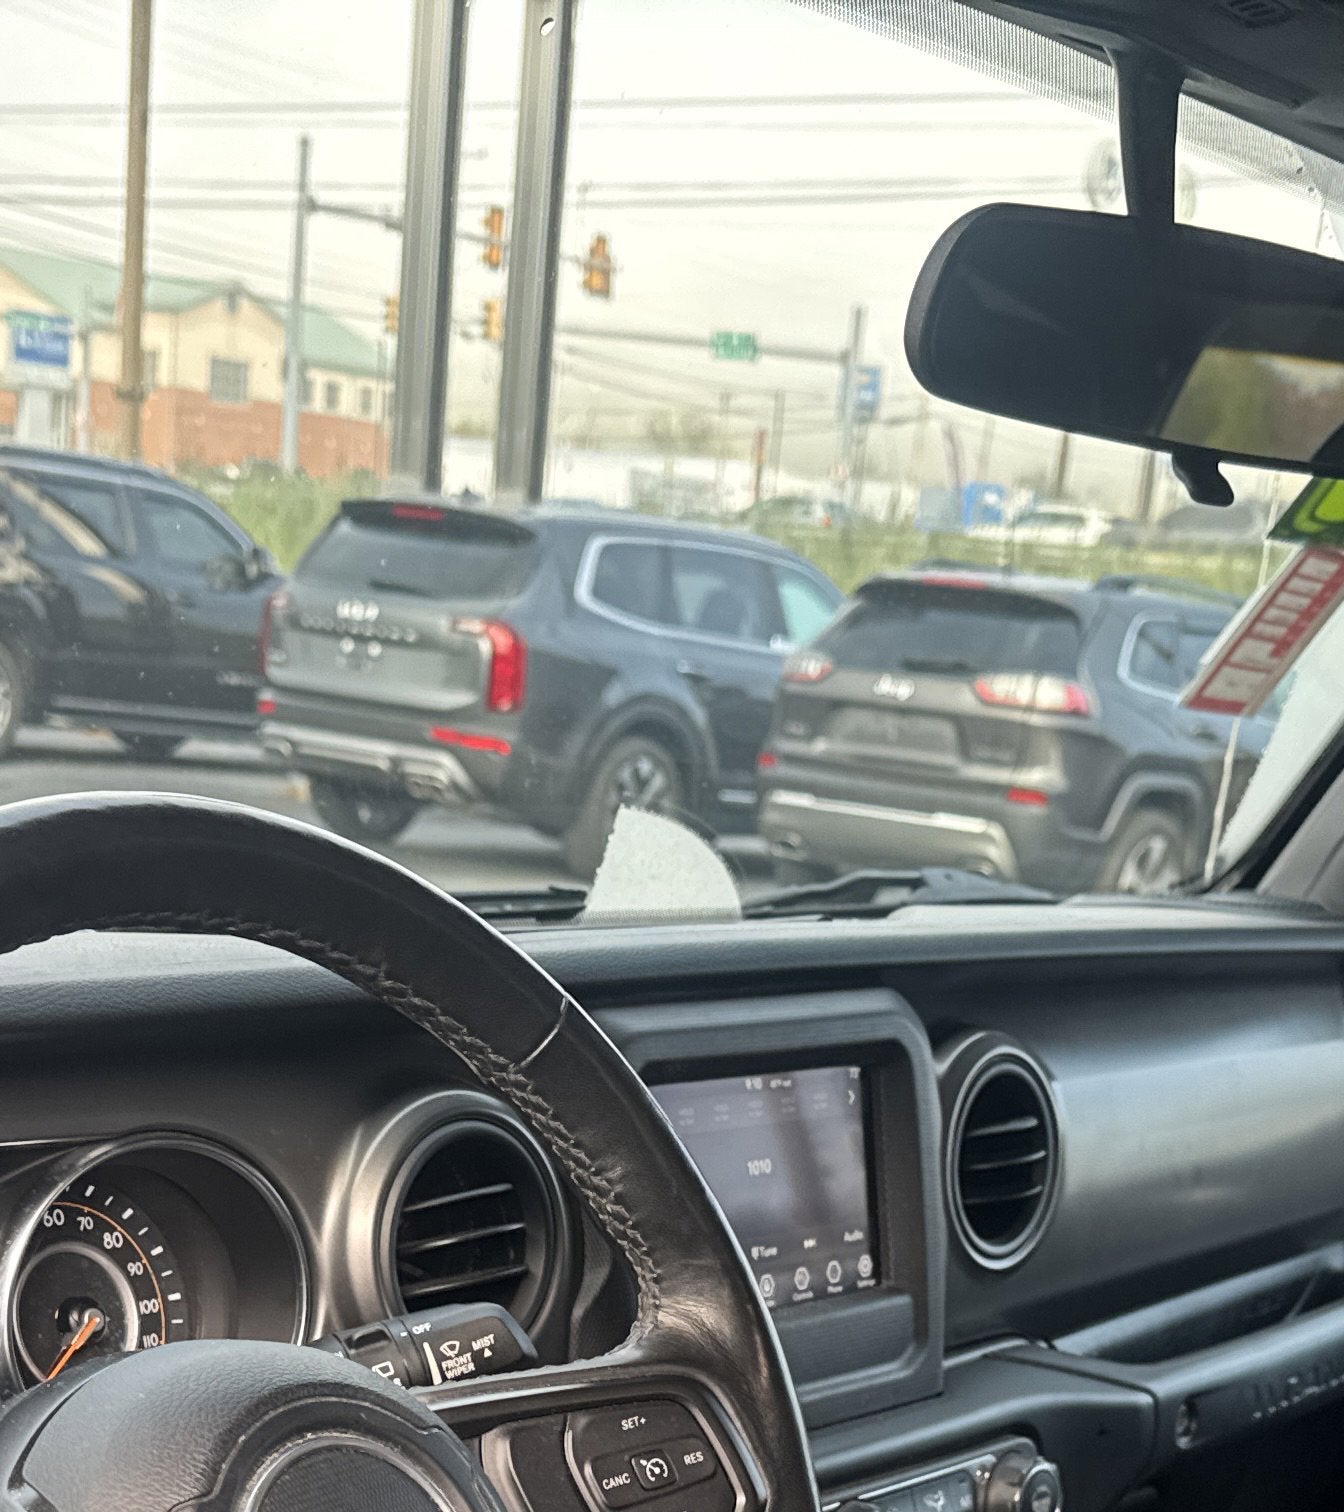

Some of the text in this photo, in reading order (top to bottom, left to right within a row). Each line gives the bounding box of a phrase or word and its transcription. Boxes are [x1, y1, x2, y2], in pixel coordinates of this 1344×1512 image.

[747, 1158, 772, 1176] 1010
[43, 1209, 65, 1228] 60
[76, 1216, 94, 1232] 70
[103, 1232, 124, 1250] 80
[127, 1262, 143, 1276] 90
[139, 1299, 159, 1315] 100
[412, 1322, 433, 1335] OFF
[143, 1332, 159, 1348] 110
[472, 1333, 496, 1352] MIST
[441, 1352, 474, 1371] FRONT
[444, 1363, 477, 1380] WIPER
[683, 1451, 705, 1466] RES
[602, 1472, 631, 1490] CANC
